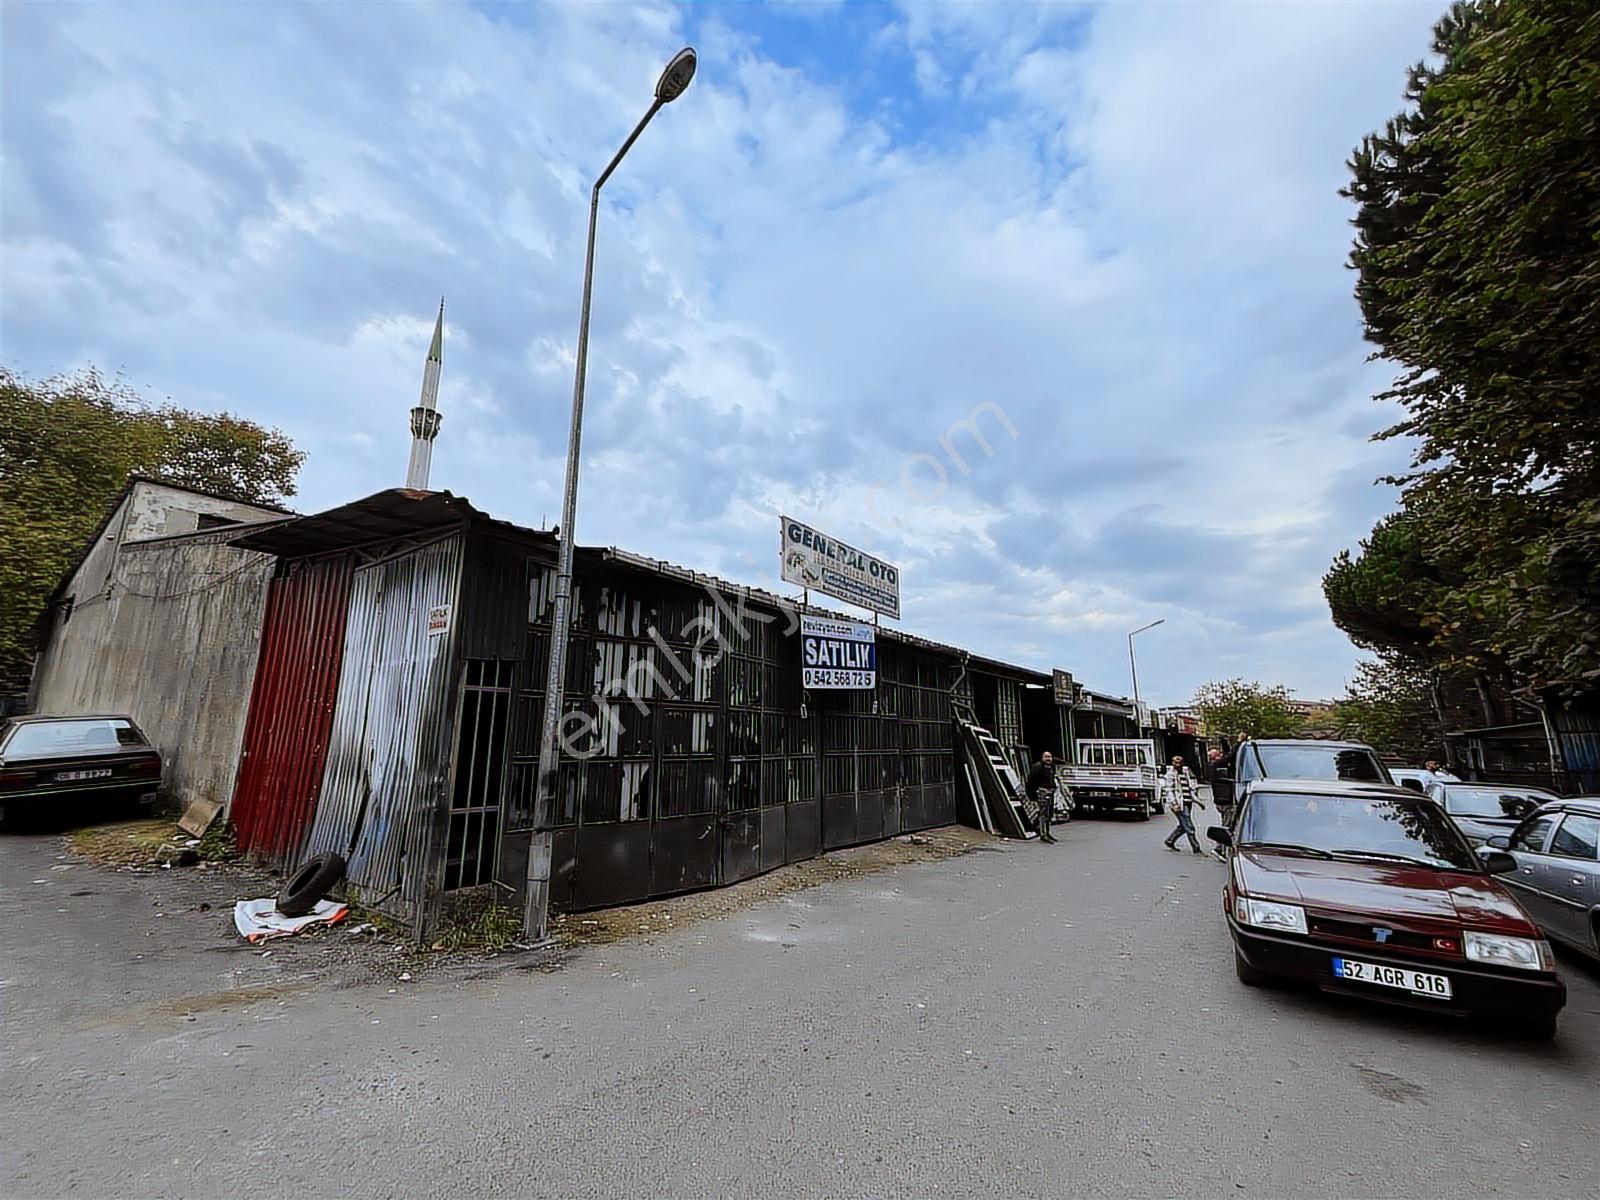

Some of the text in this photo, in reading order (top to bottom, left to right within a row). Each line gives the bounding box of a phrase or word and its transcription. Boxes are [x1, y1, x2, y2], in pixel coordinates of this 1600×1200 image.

[788, 523, 865, 572] GENERAL
[869, 560, 896, 585] OTO
[805, 638, 870, 668] SATILIK
[814, 671, 832, 686] 542
[1343, 961, 1364, 979] 52
[1373, 966, 1406, 987] AGR
[1414, 973, 1446, 994] 616
